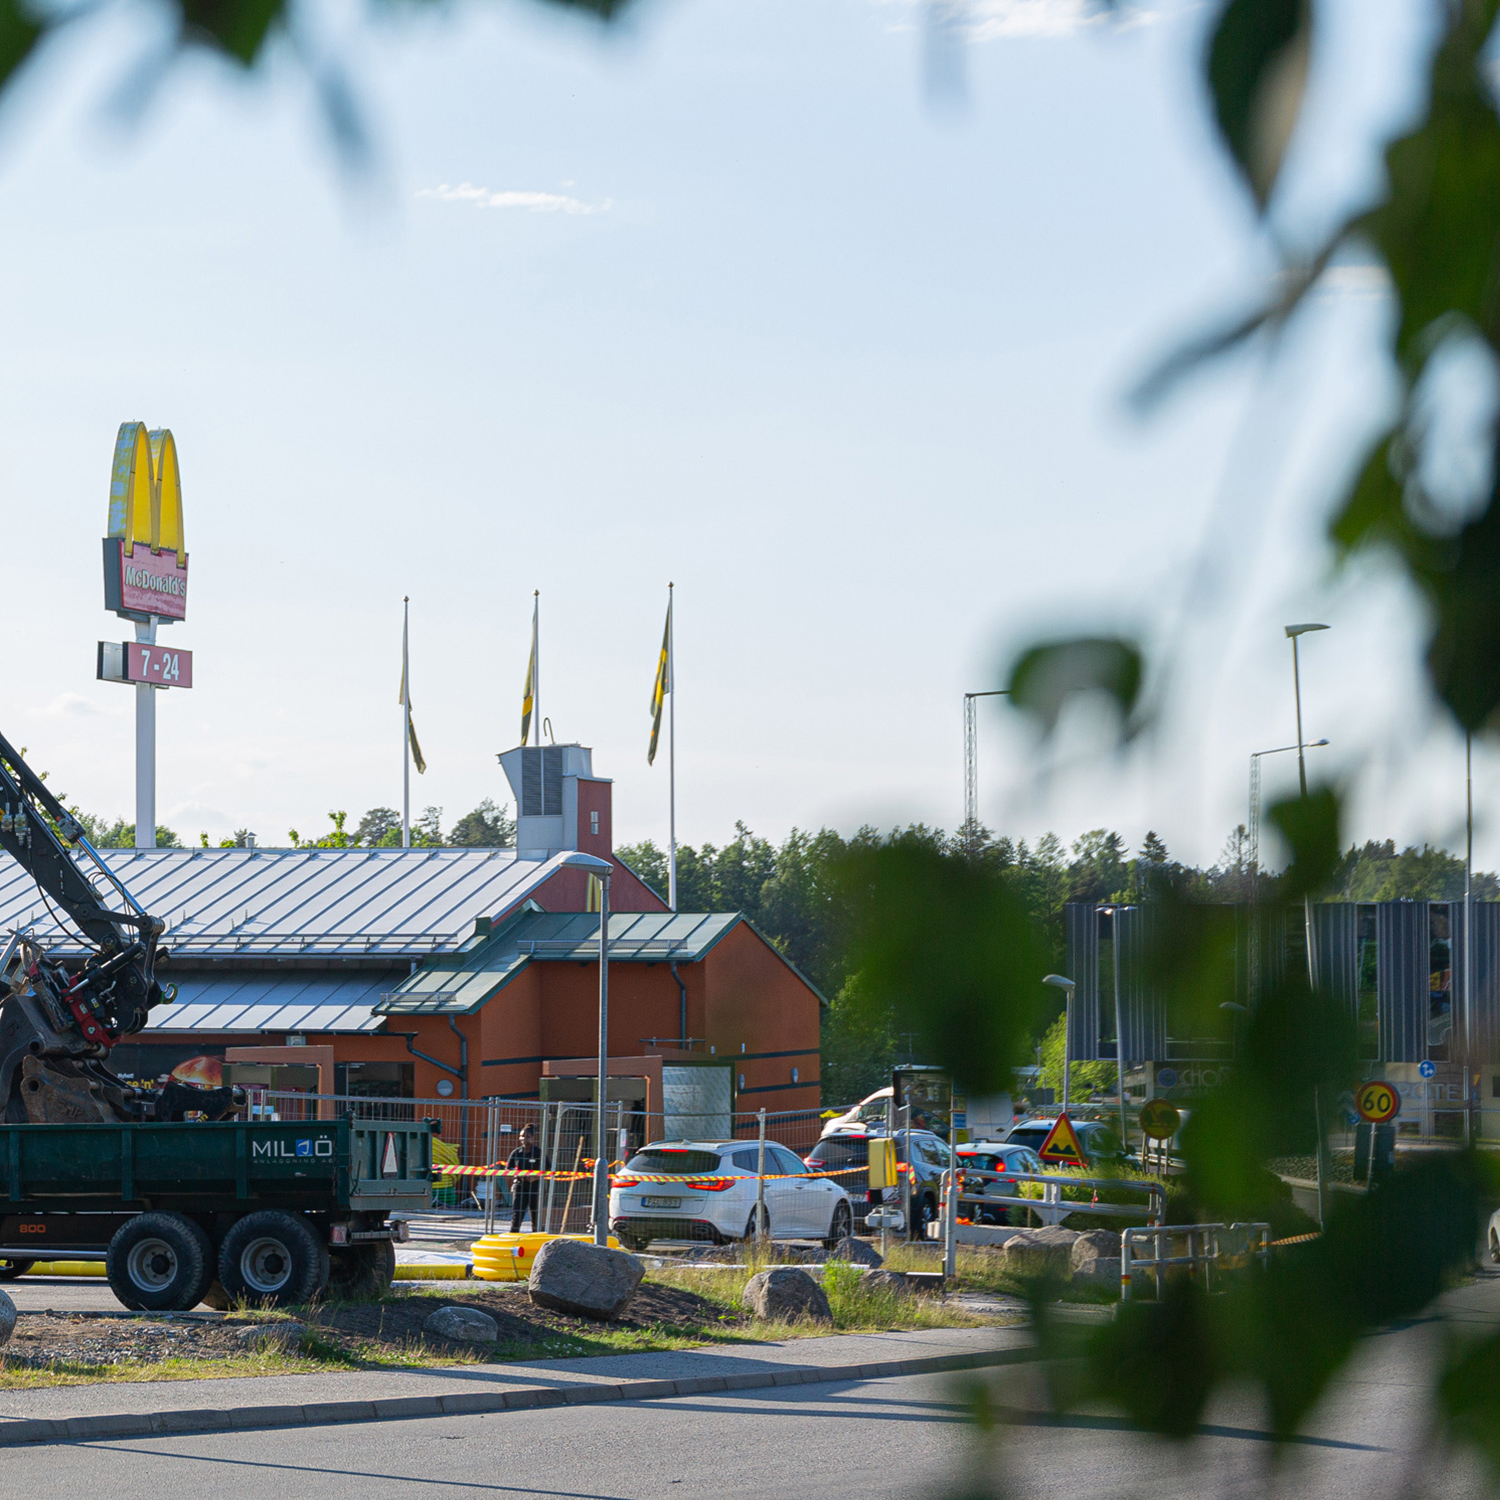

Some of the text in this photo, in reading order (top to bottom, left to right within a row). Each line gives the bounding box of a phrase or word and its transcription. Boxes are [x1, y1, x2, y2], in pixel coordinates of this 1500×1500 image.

[125, 565, 186, 598] McDonald's
[141, 649, 151, 677] 7
[163, 652, 180, 681] 24
[1362, 1091, 1391, 1113] 60
[19, 1224, 46, 1234] 800
